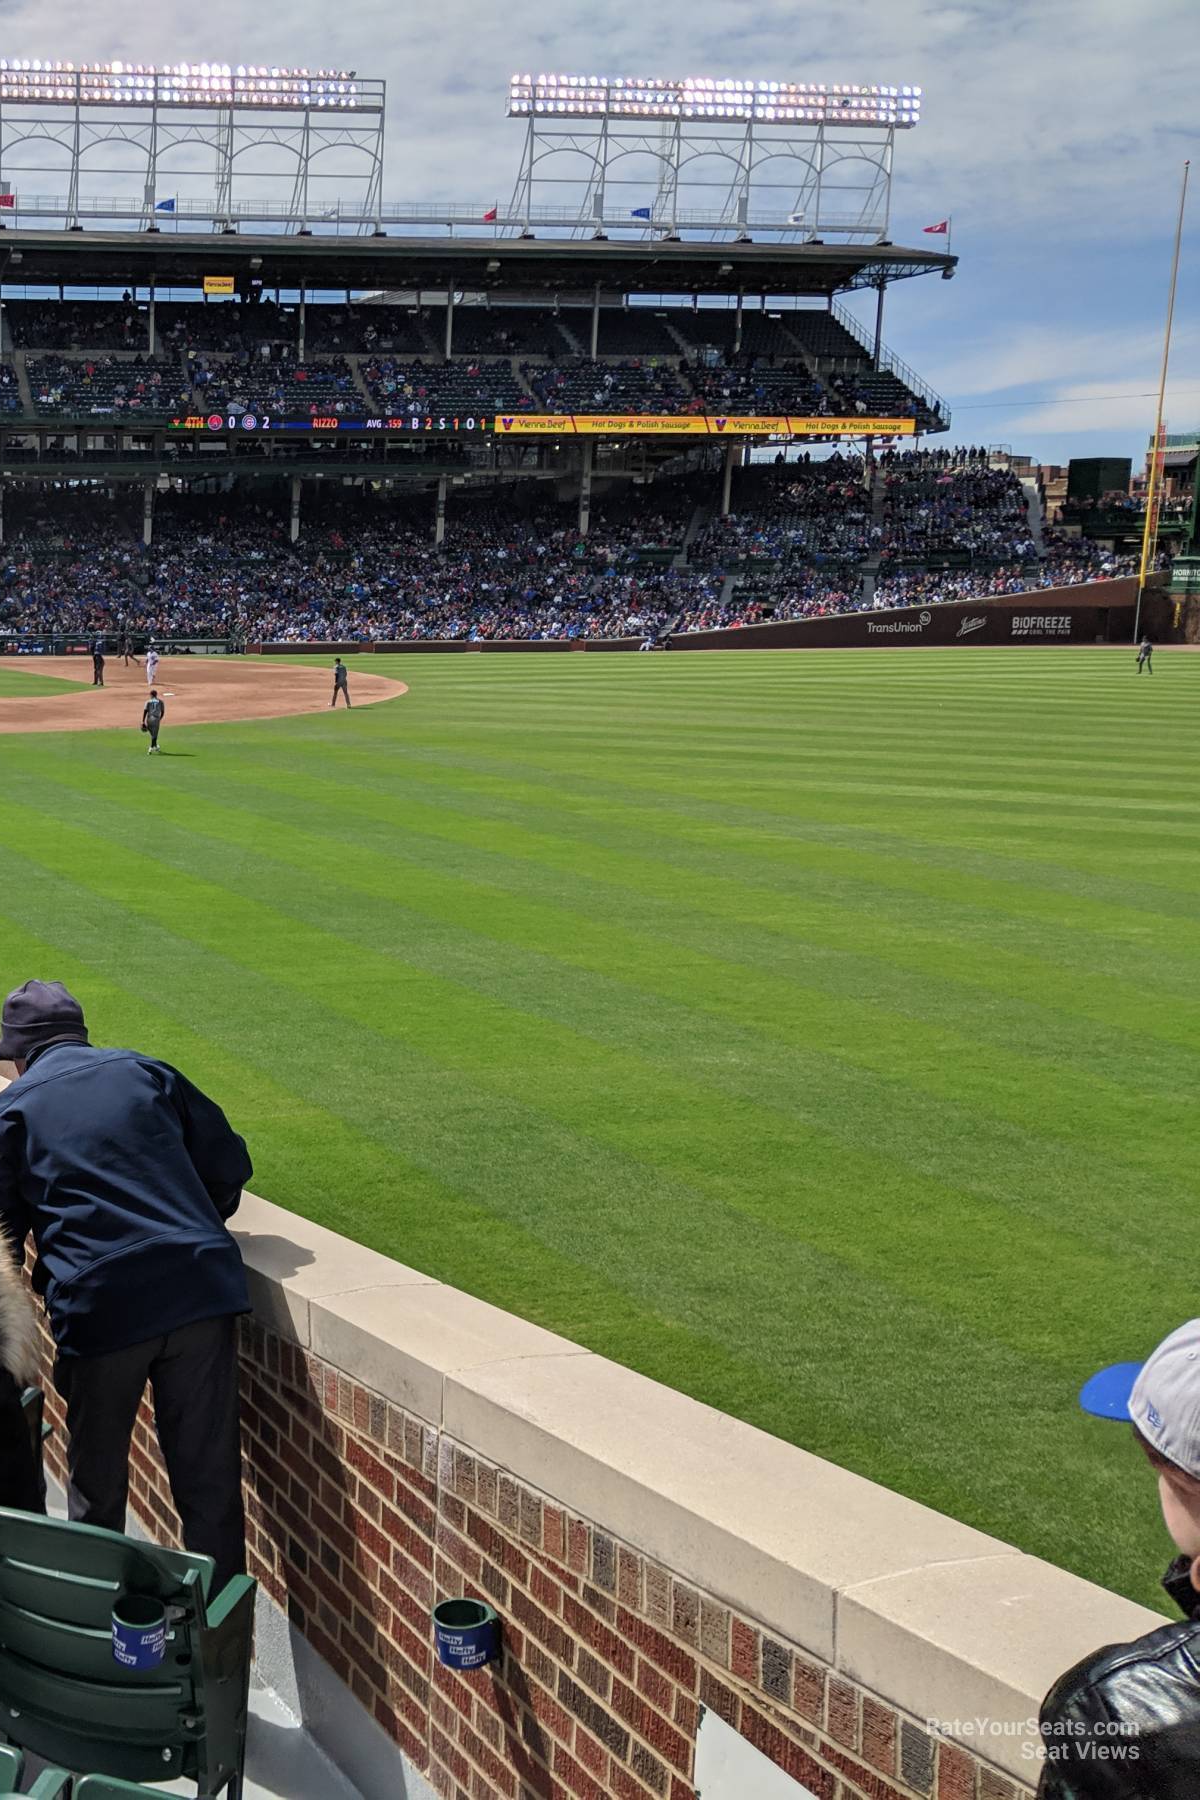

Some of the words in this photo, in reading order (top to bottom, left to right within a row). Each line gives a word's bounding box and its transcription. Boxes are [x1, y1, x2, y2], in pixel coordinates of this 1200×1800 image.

[185, 417, 204, 428] 4TH
[228, 416, 235, 428] 0
[263, 416, 270, 428] 2
[312, 418, 337, 428] RIZZO
[366, 419, 382, 428] AVG
[412, 417, 419, 429] B
[425, 417, 432, 429] 2
[439, 417, 445, 429] S
[453, 418, 459, 430] 1
[480, 418, 486, 430] 1
[609, 421, 626, 429] Dogs
[661, 422, 690, 430] Sausage
[821, 423, 839, 431] Dogs
[849, 422, 870, 430] Polish
[872, 423, 901, 432] Sausage
[867, 622, 922, 633] TransUnion
[449, 1645, 475, 1655] Hefty
